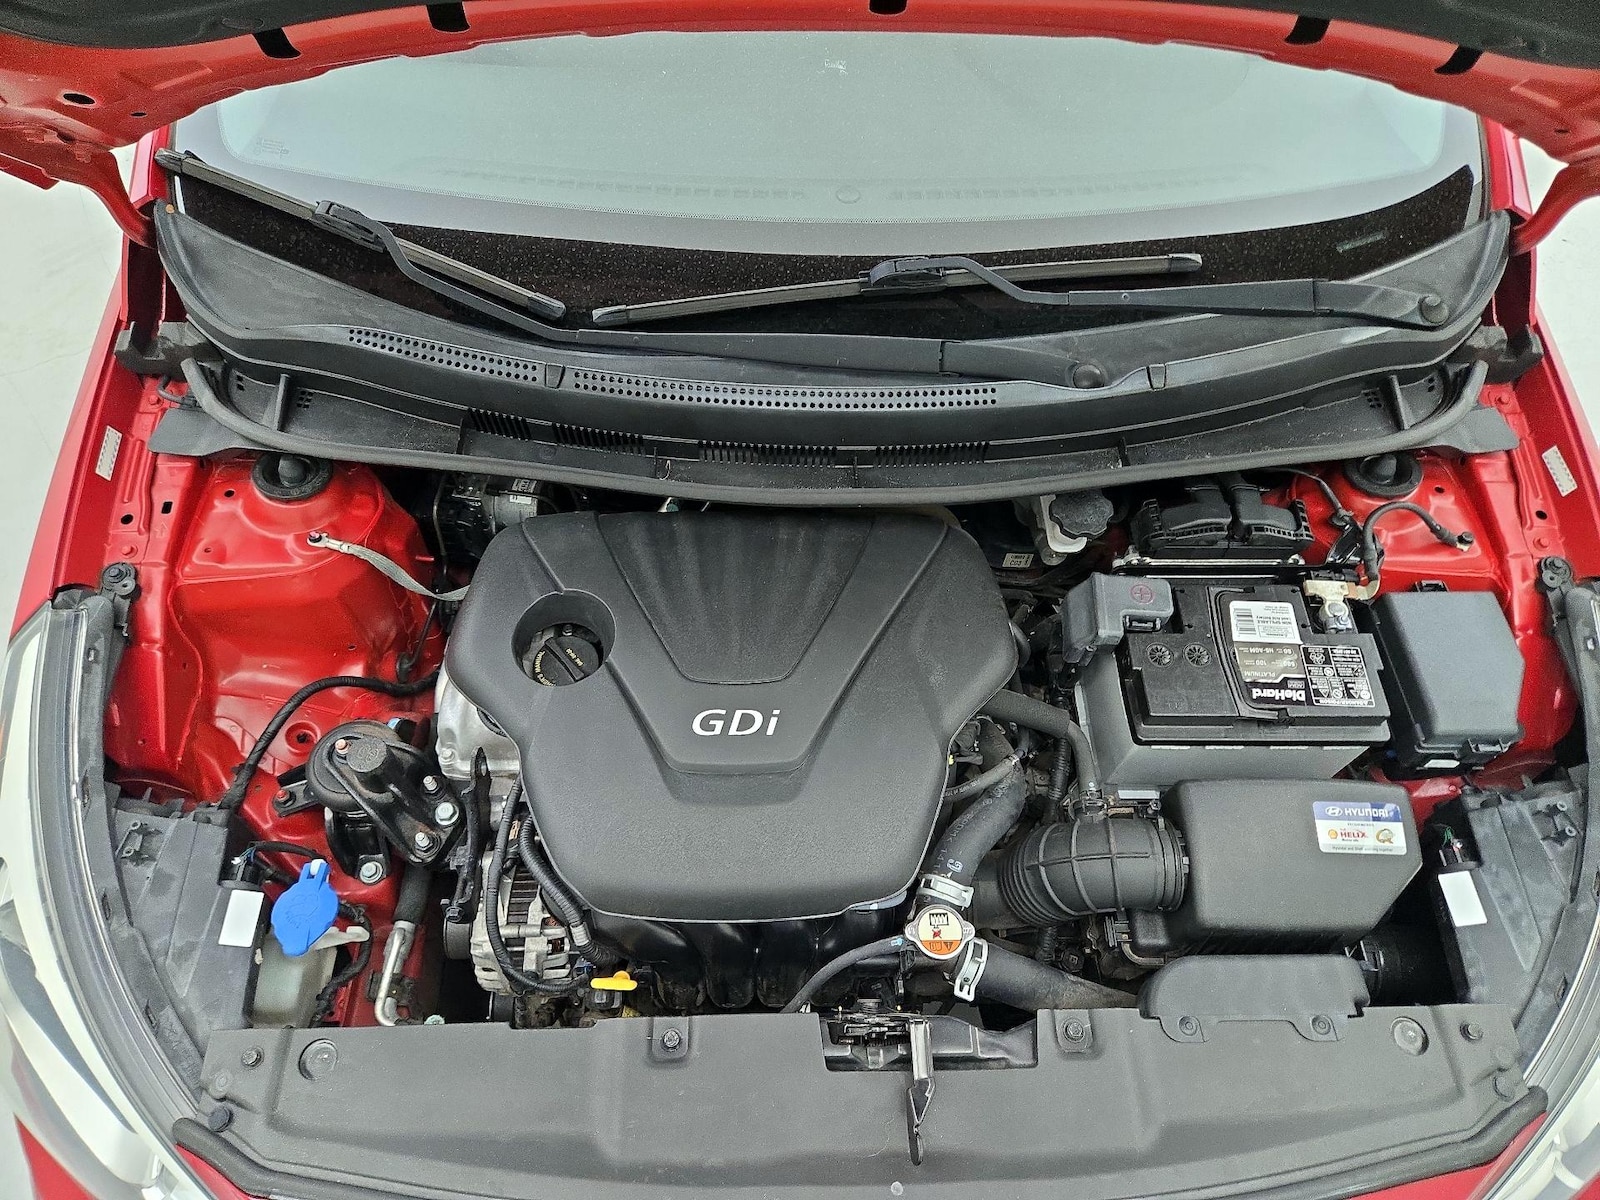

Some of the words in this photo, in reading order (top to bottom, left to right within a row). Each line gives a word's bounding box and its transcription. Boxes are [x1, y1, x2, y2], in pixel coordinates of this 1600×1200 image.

[1252, 688, 1306, 702] DieHard
[691, 708, 781, 736] GDi
[1344, 808, 1389, 818] HYUNDAI
